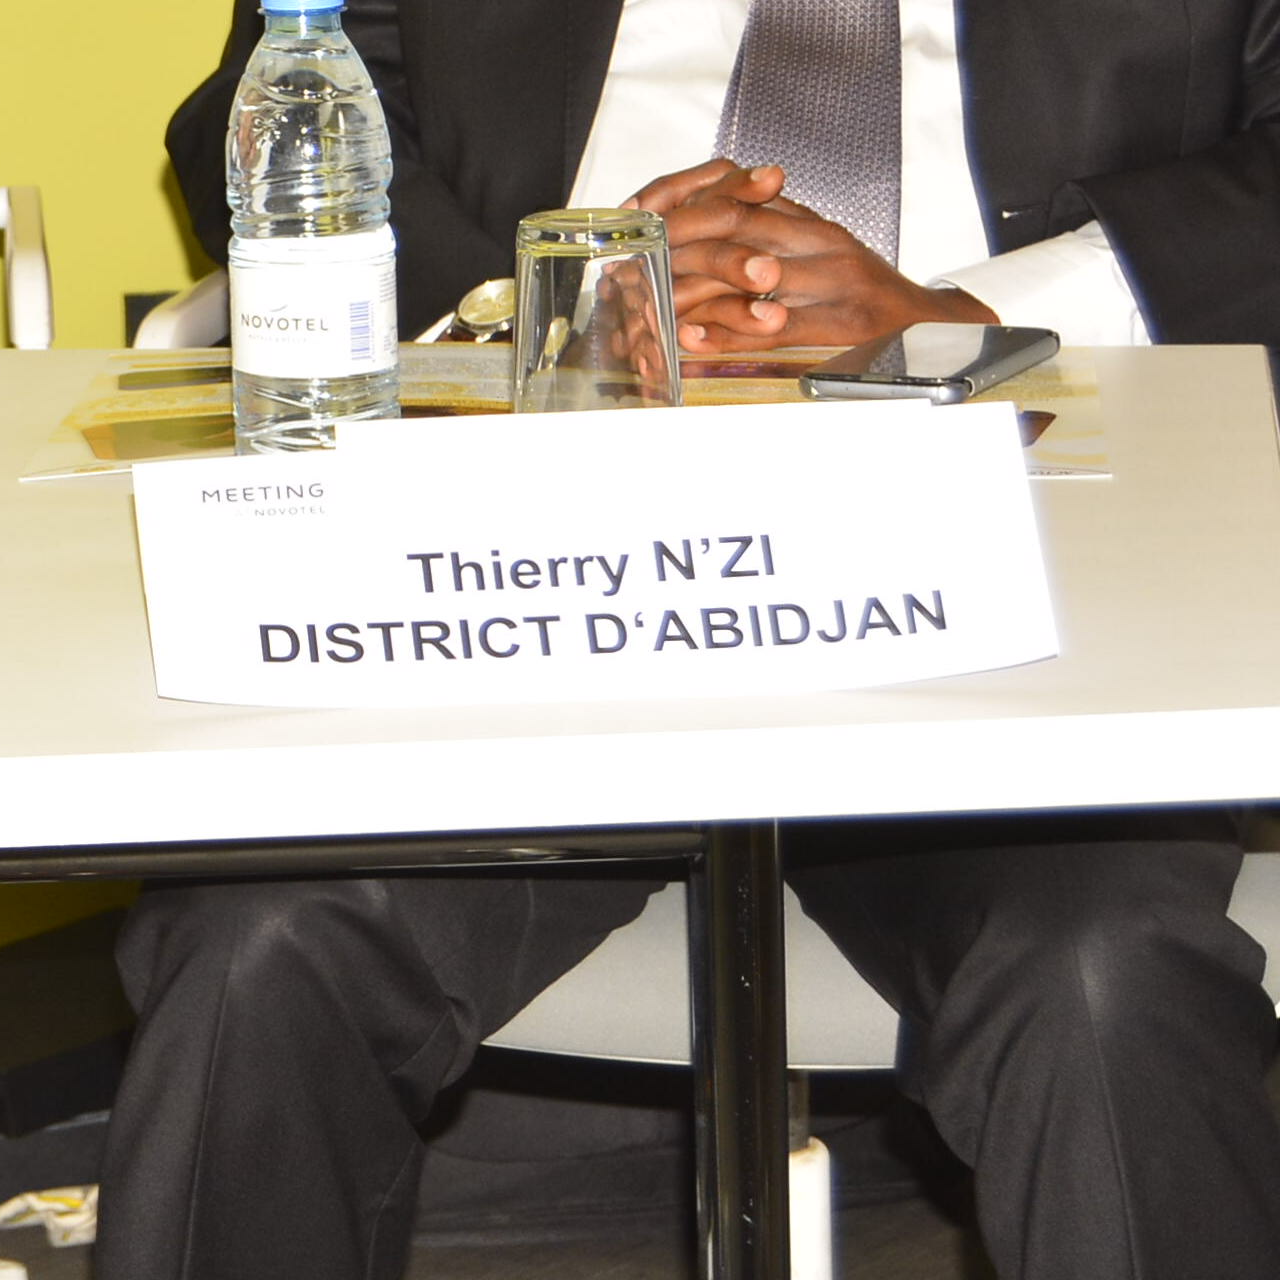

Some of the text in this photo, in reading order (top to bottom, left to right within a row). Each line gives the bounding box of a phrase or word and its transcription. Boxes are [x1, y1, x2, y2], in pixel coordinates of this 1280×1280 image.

[240, 312, 329, 332] NOVOTEL
[201, 482, 325, 503] MEETING
[254, 505, 326, 517] NOVOTEL
[406, 534, 775, 597] Thierry N’ZI
[259, 615, 561, 664] DISTRICT
